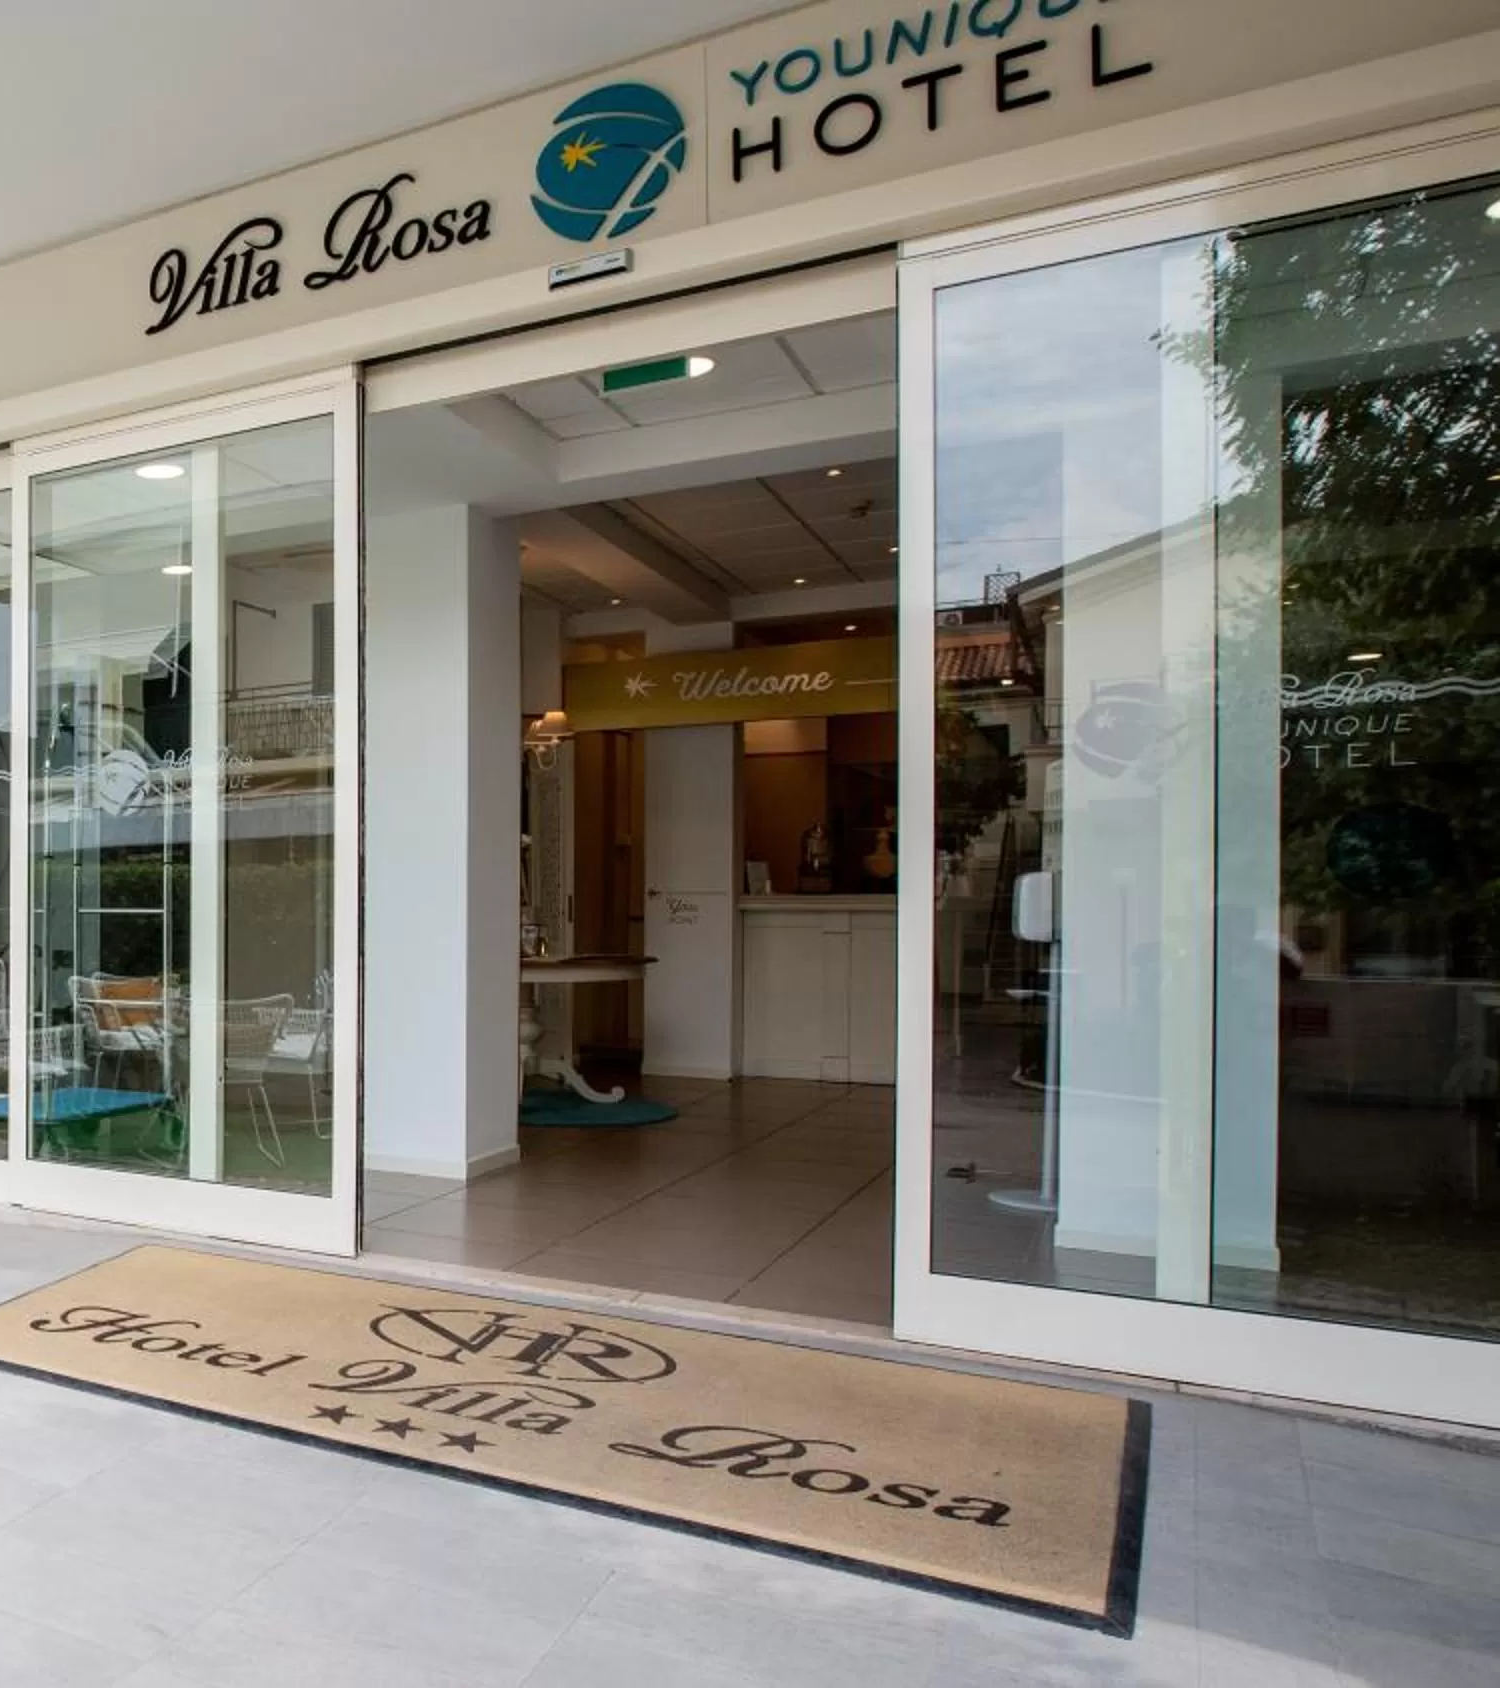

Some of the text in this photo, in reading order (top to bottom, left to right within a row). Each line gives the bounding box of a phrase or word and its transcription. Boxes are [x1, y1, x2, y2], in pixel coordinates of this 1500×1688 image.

[729, 0, 1116, 107] YOUNIQ
[732, 23, 1153, 183] HOTEL
[145, 172, 492, 335] Villa Rosa
[671, 665, 834, 701] Welcome
[29, 1305, 1011, 1528] Hotel Villa Rosa
